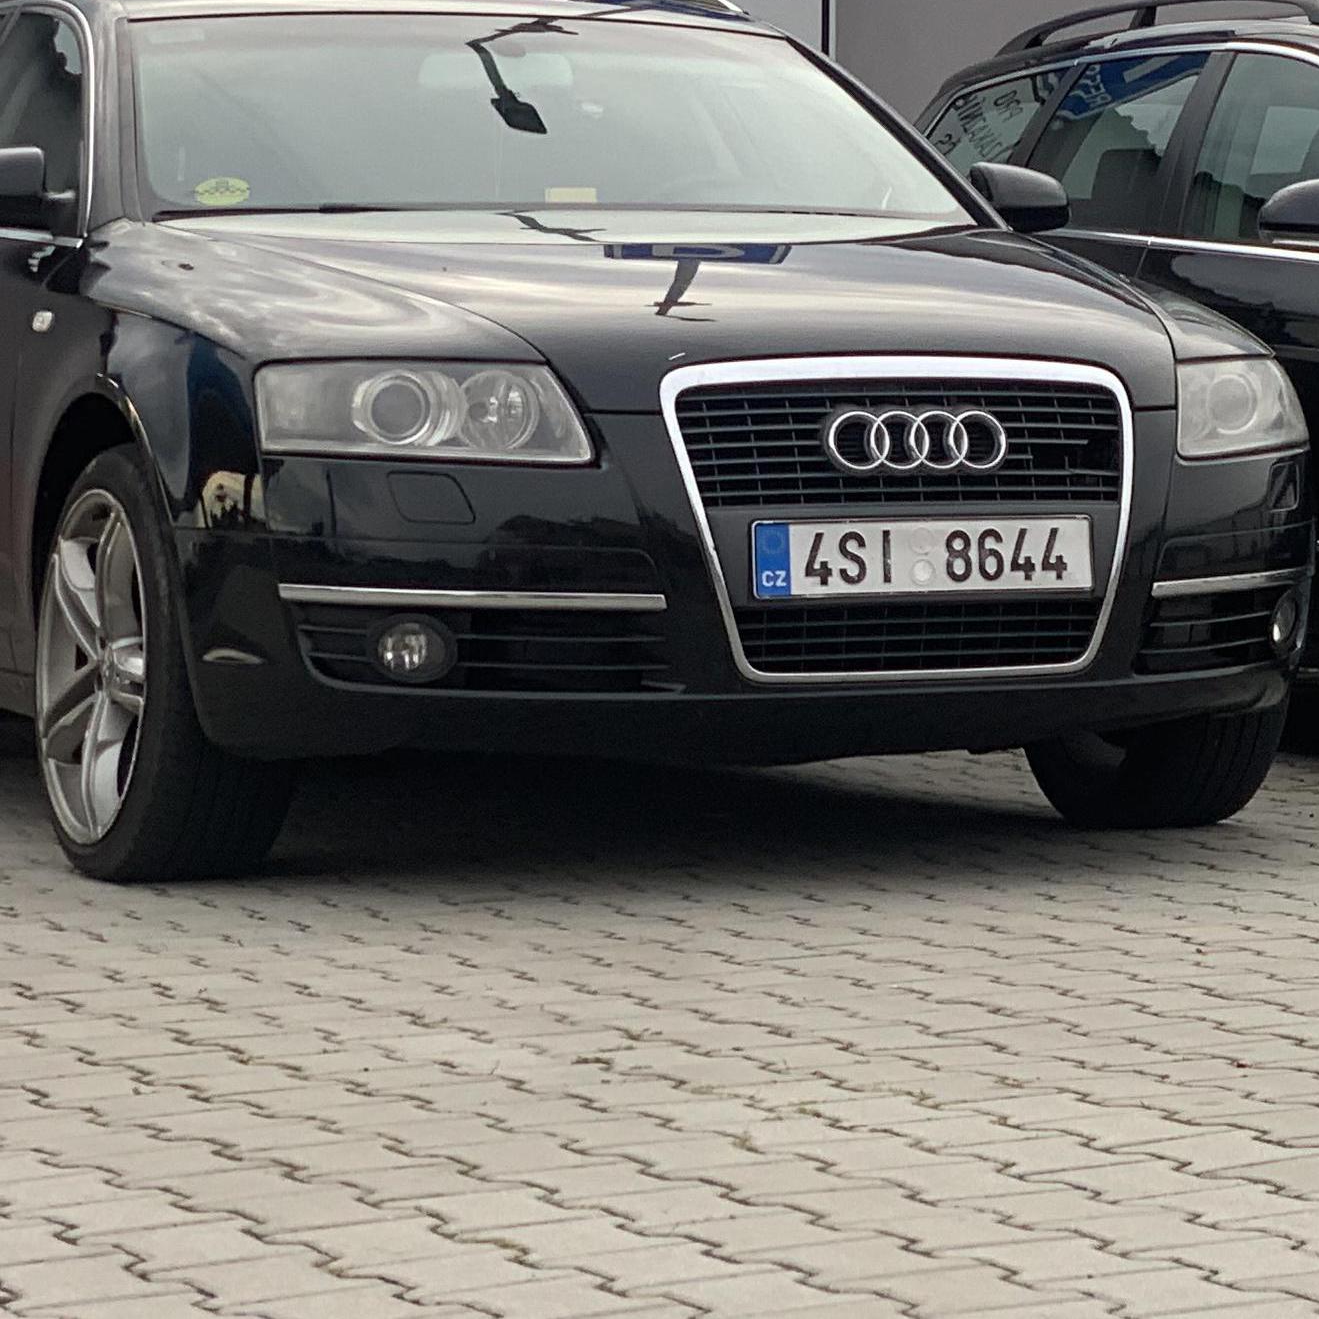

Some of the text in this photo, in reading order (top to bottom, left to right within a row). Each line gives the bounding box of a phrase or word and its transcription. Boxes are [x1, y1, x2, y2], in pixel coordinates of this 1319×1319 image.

[762, 527, 1068, 587] CZ 4SI 8644
